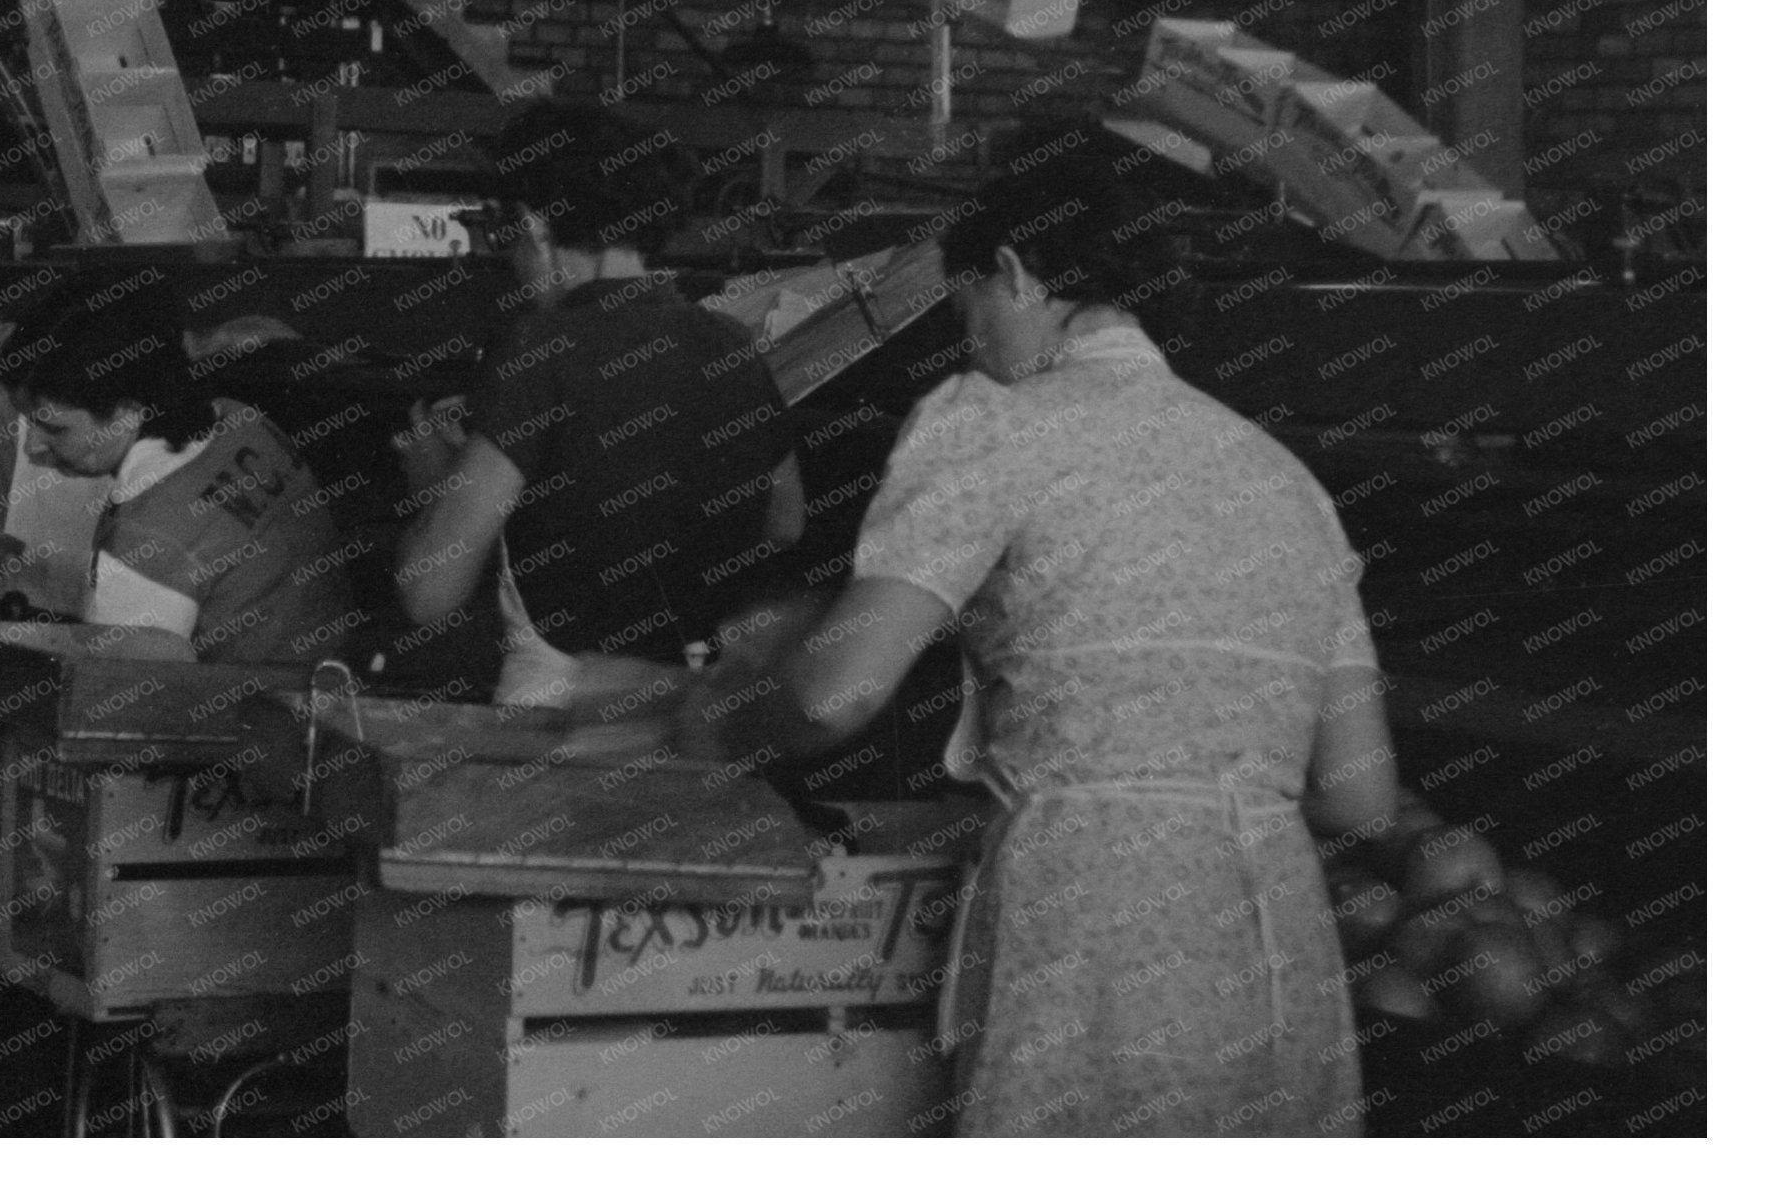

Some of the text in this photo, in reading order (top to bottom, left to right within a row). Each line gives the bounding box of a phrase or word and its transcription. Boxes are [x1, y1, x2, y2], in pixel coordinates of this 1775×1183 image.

[412, 215, 447, 241] NO
[688, 974, 740, 996] JUST
[755, 965, 885, 1003] Naturally
